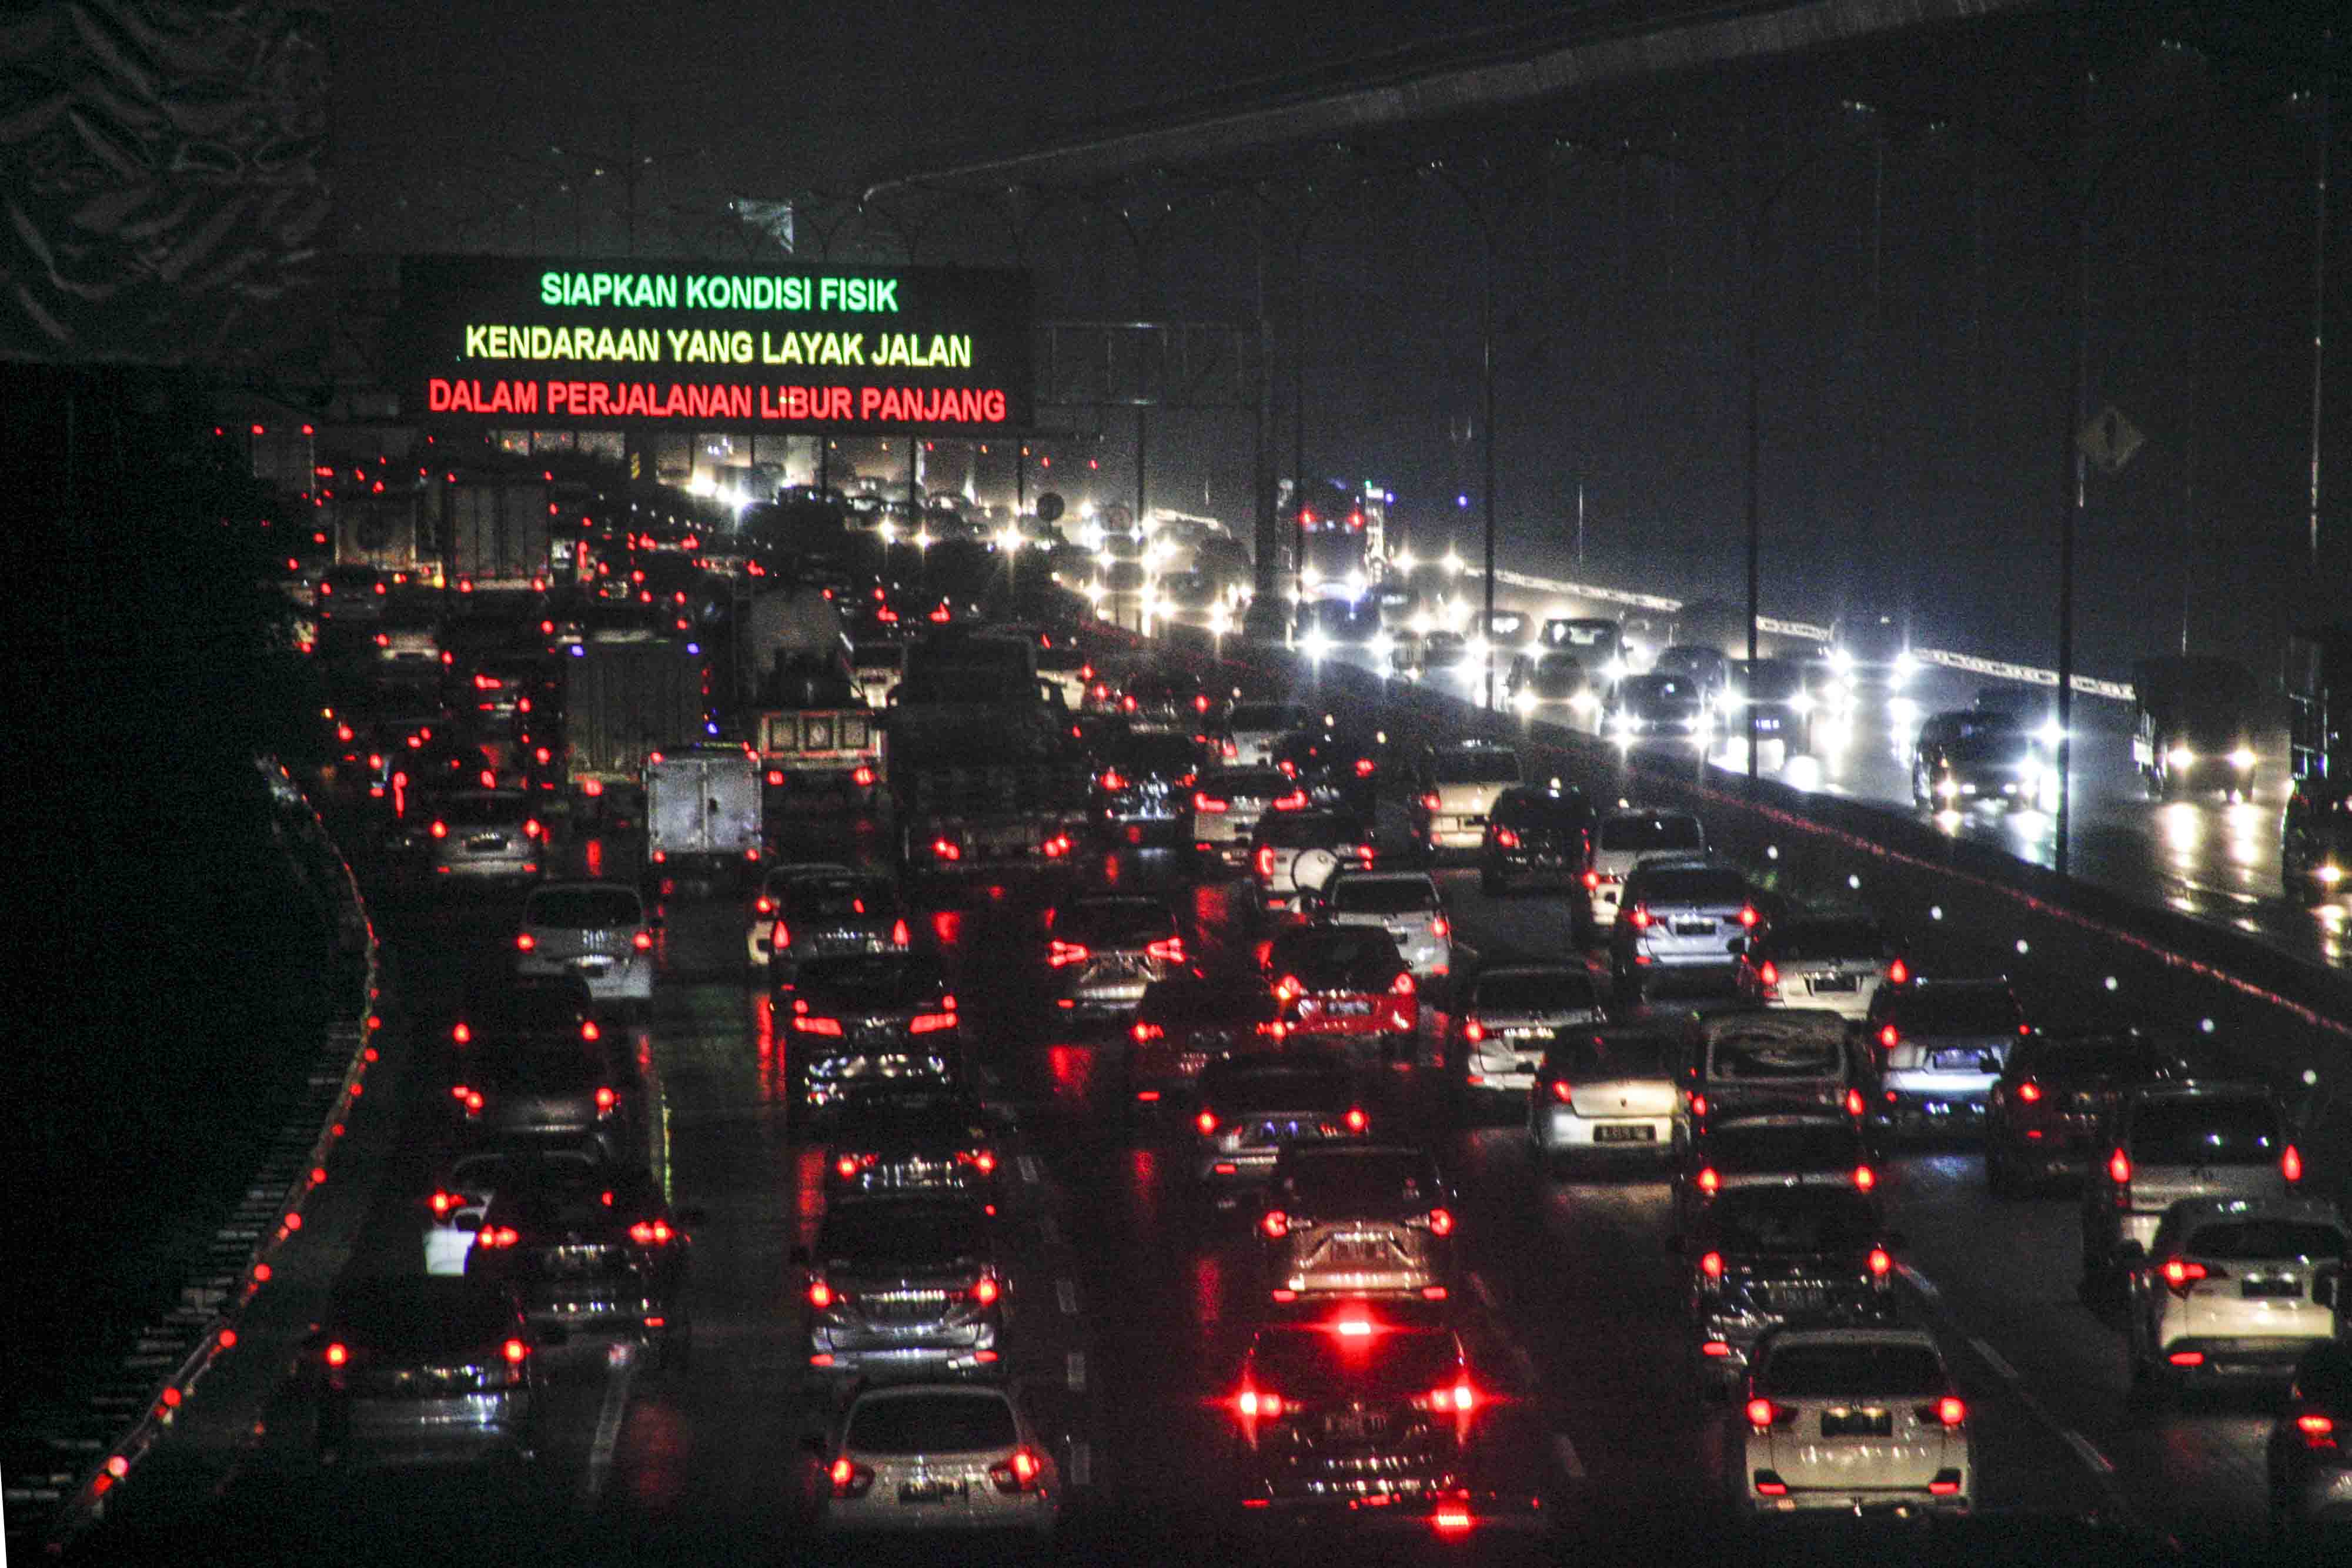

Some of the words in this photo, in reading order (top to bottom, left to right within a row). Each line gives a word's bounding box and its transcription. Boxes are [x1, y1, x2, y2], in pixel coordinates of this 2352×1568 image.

[540, 272, 679, 309] SIAPKAN
[684, 275, 813, 311] KONDISI
[818, 277, 900, 313] FISIK
[465, 324, 661, 363] KENDARAAN
[666, 328, 754, 364] YANG
[760, 330, 866, 366] LAYAK
[869, 332, 972, 368] JALAN
[428, 377, 539, 415] DALAM
[546, 380, 753, 419] PERJALANAN
[759, 385, 854, 421] LIBUR
[859, 386, 1007, 423] PANJANG
